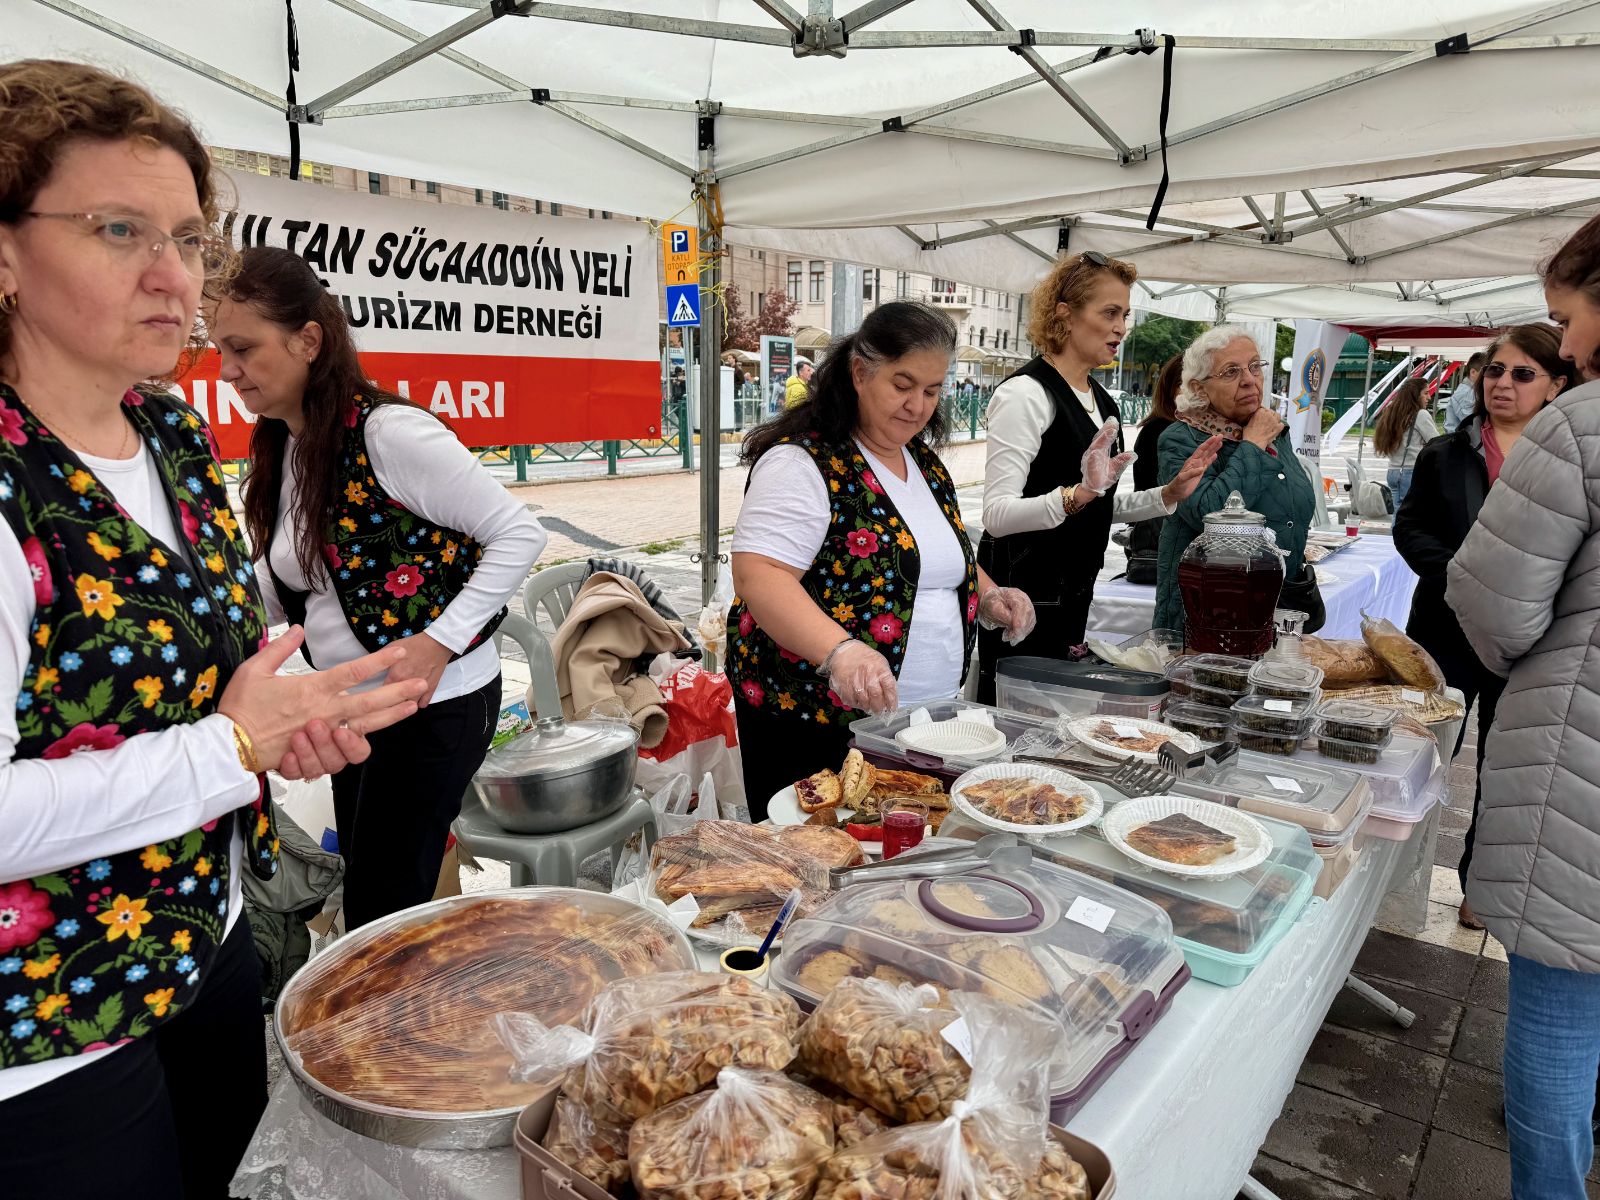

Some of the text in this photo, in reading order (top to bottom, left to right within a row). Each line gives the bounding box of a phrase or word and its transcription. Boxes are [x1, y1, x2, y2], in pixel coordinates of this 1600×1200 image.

[673, 232, 686, 252] P
[570, 245, 632, 298] VELİ
[332, 291, 602, 339] URİZM DERNEĞİ
